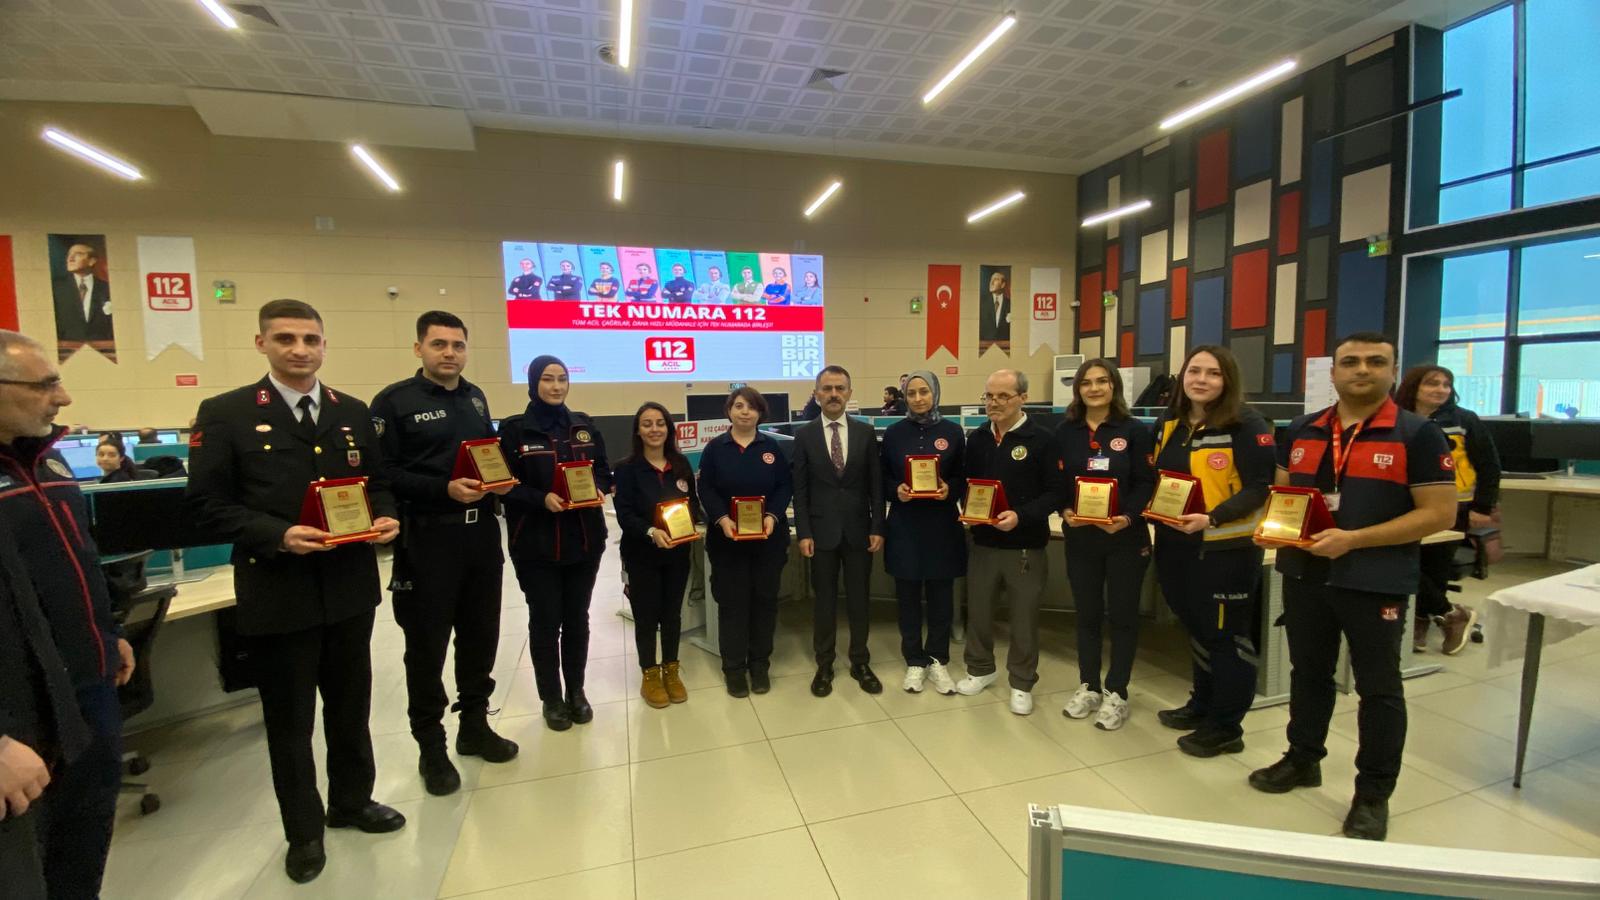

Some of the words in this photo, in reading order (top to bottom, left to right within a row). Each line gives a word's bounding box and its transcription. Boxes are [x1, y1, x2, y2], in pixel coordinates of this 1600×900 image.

[153, 277, 185, 295] 112
[1037, 297, 1053, 309] 112
[579, 304, 621, 318] TEK
[627, 305, 726, 320] NUMARA
[732, 307, 766, 320] 112
[652, 340, 688, 358] 112
[680, 426, 695, 438] 112
[1377, 455, 1392, 463] 112
